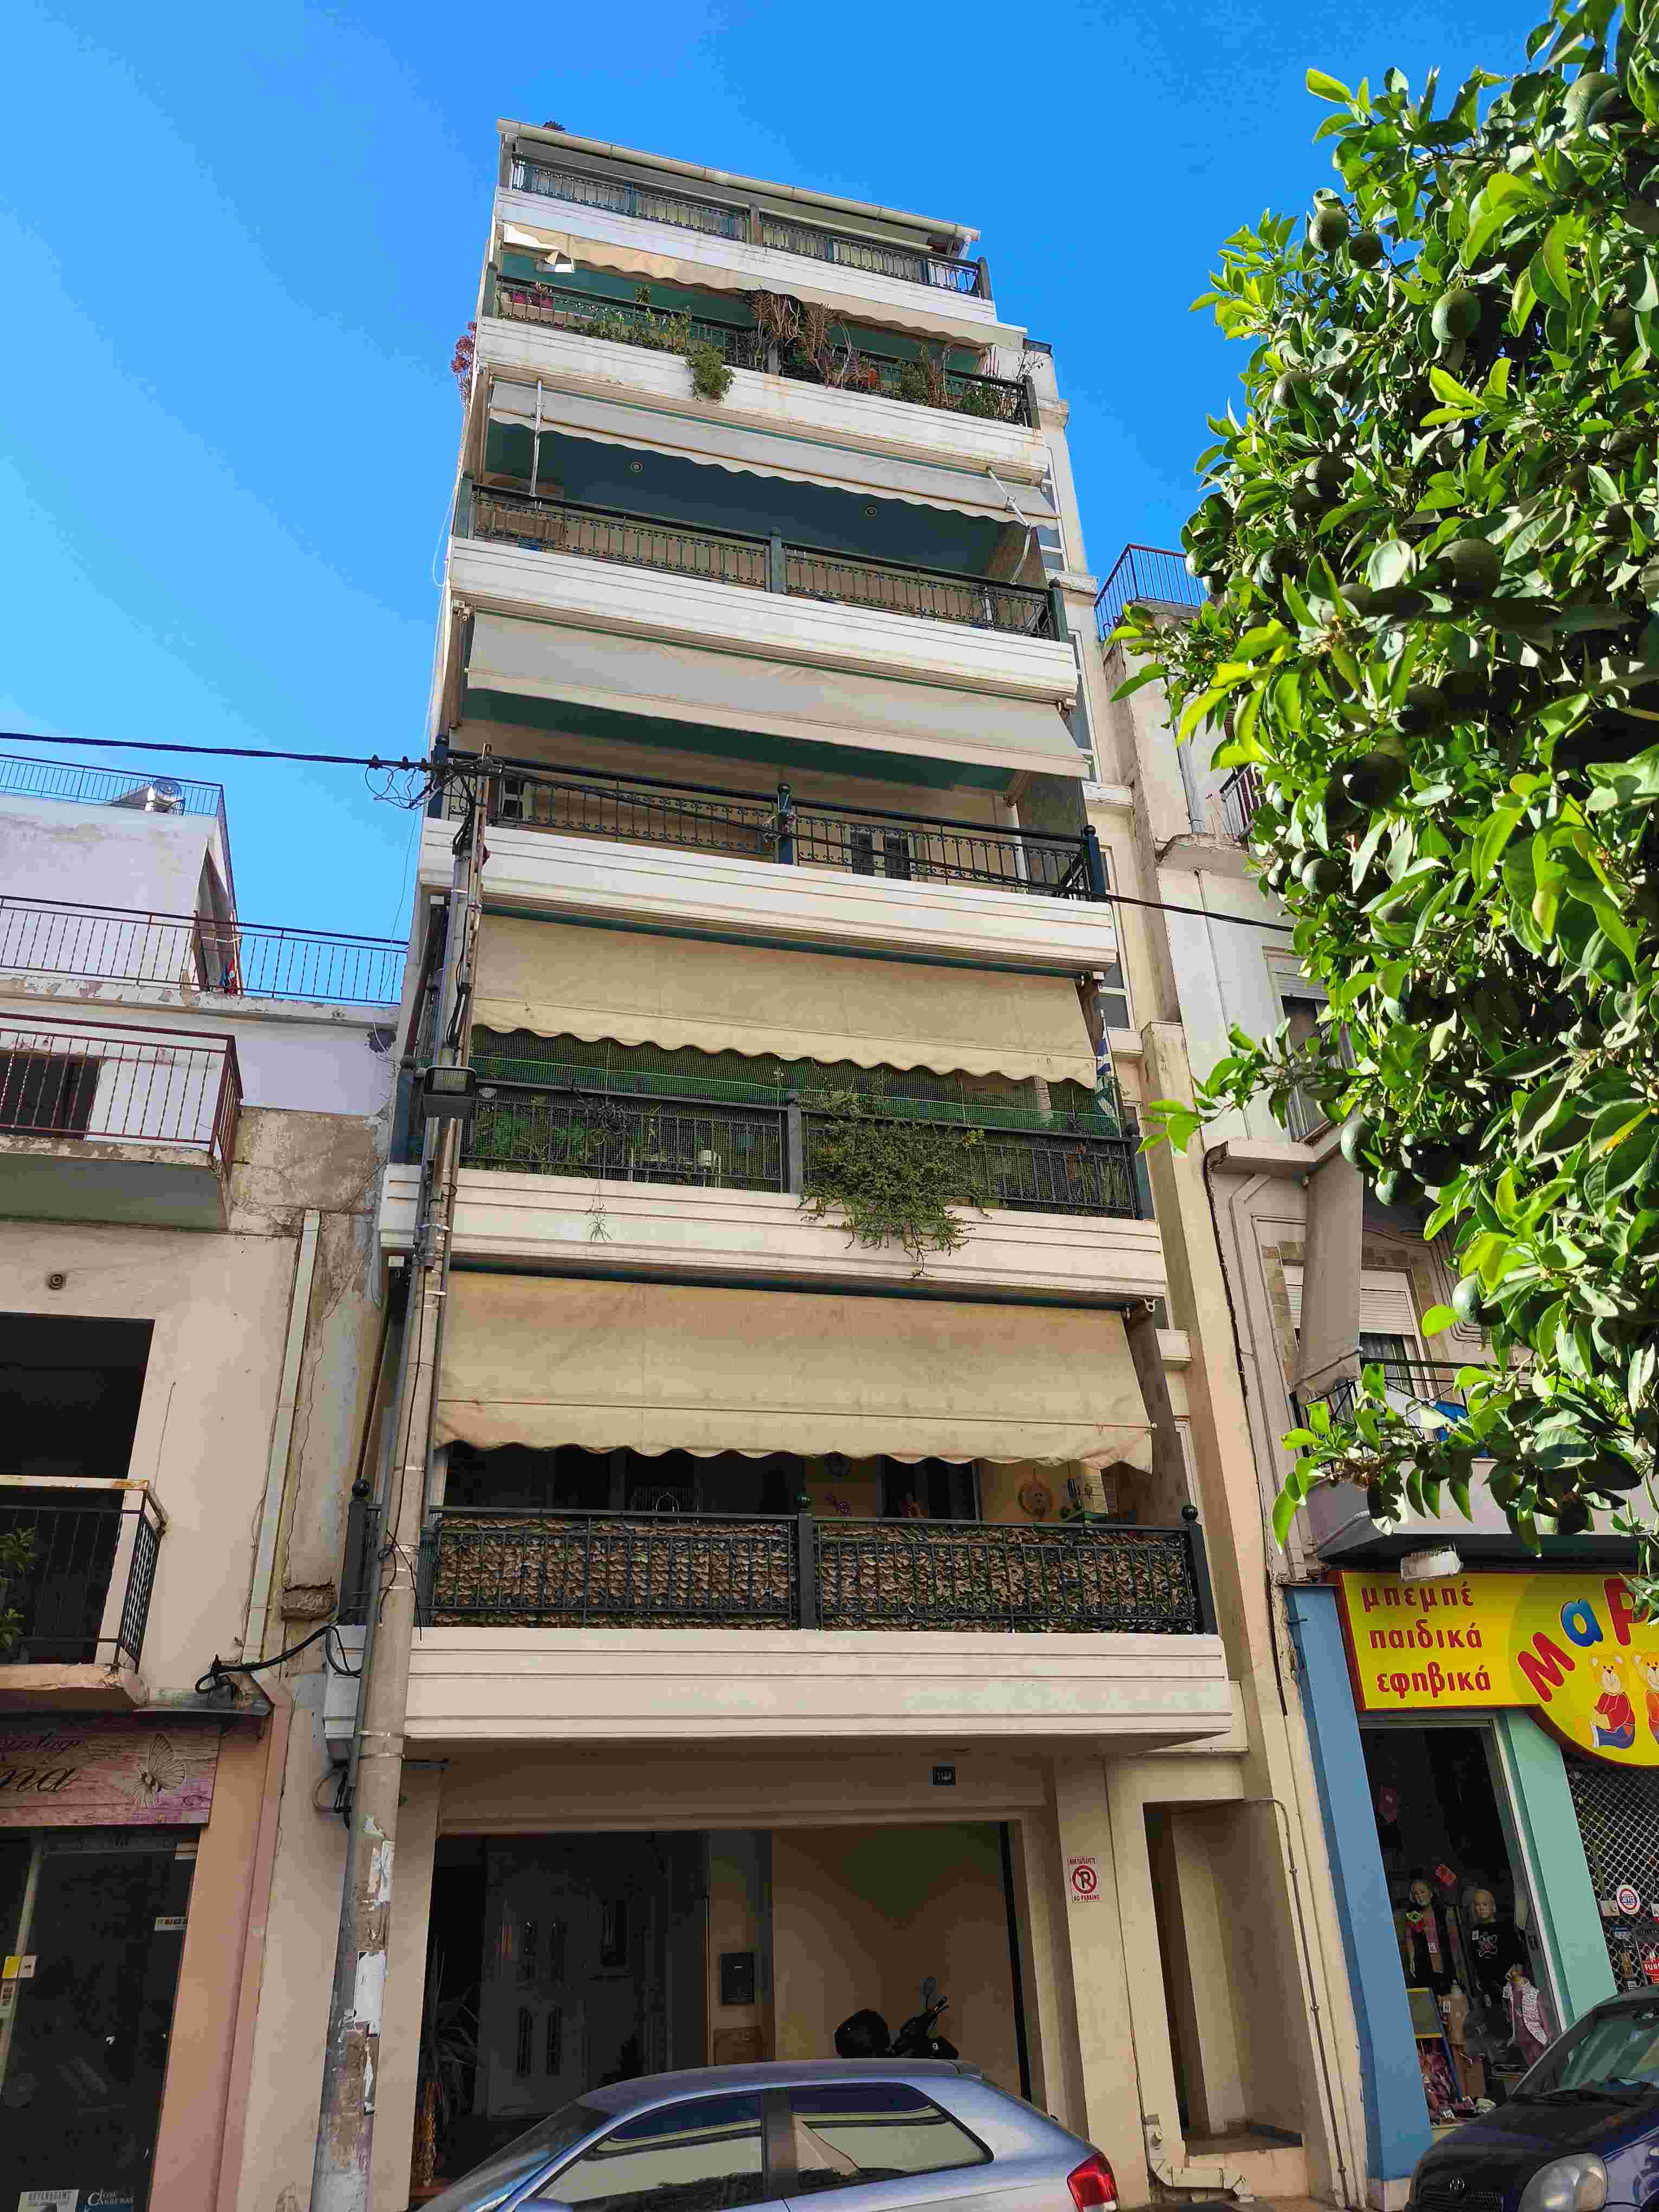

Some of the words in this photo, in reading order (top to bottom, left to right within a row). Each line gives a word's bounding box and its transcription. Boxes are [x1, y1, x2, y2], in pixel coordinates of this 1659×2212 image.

[1361, 1580, 1474, 1613] μπεμπέ
[1369, 1619, 1482, 1648] παιδικά
[1377, 1661, 1491, 1699] εφηβικά
